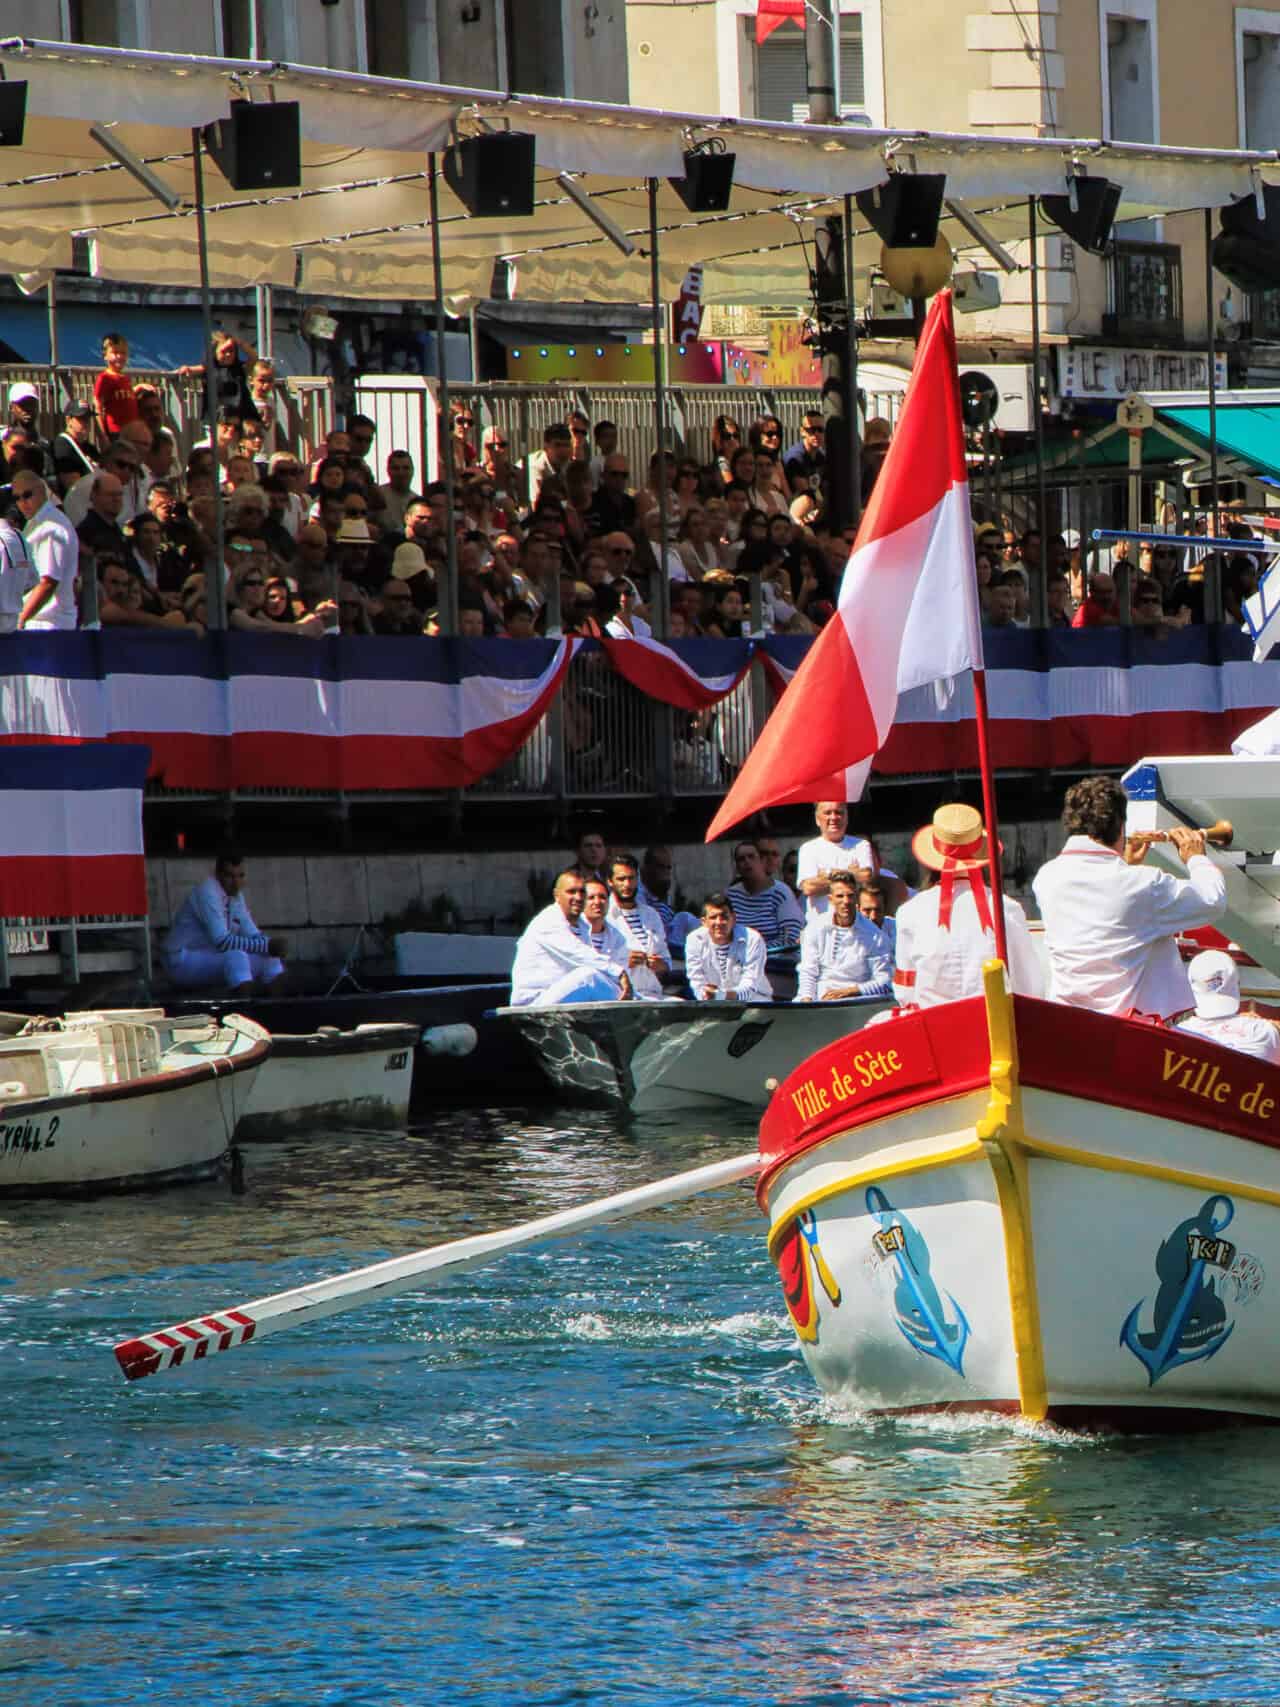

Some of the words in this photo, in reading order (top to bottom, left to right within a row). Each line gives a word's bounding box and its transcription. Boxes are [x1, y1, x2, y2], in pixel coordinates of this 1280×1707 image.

[1081, 351, 1108, 392] LE
[791, 1079, 832, 1122] Ville
[831, 1066, 857, 1102] de
[854, 1050, 903, 1088] Sète
[1161, 1048, 1232, 1104] Ville
[1239, 1082, 1275, 1119] de
